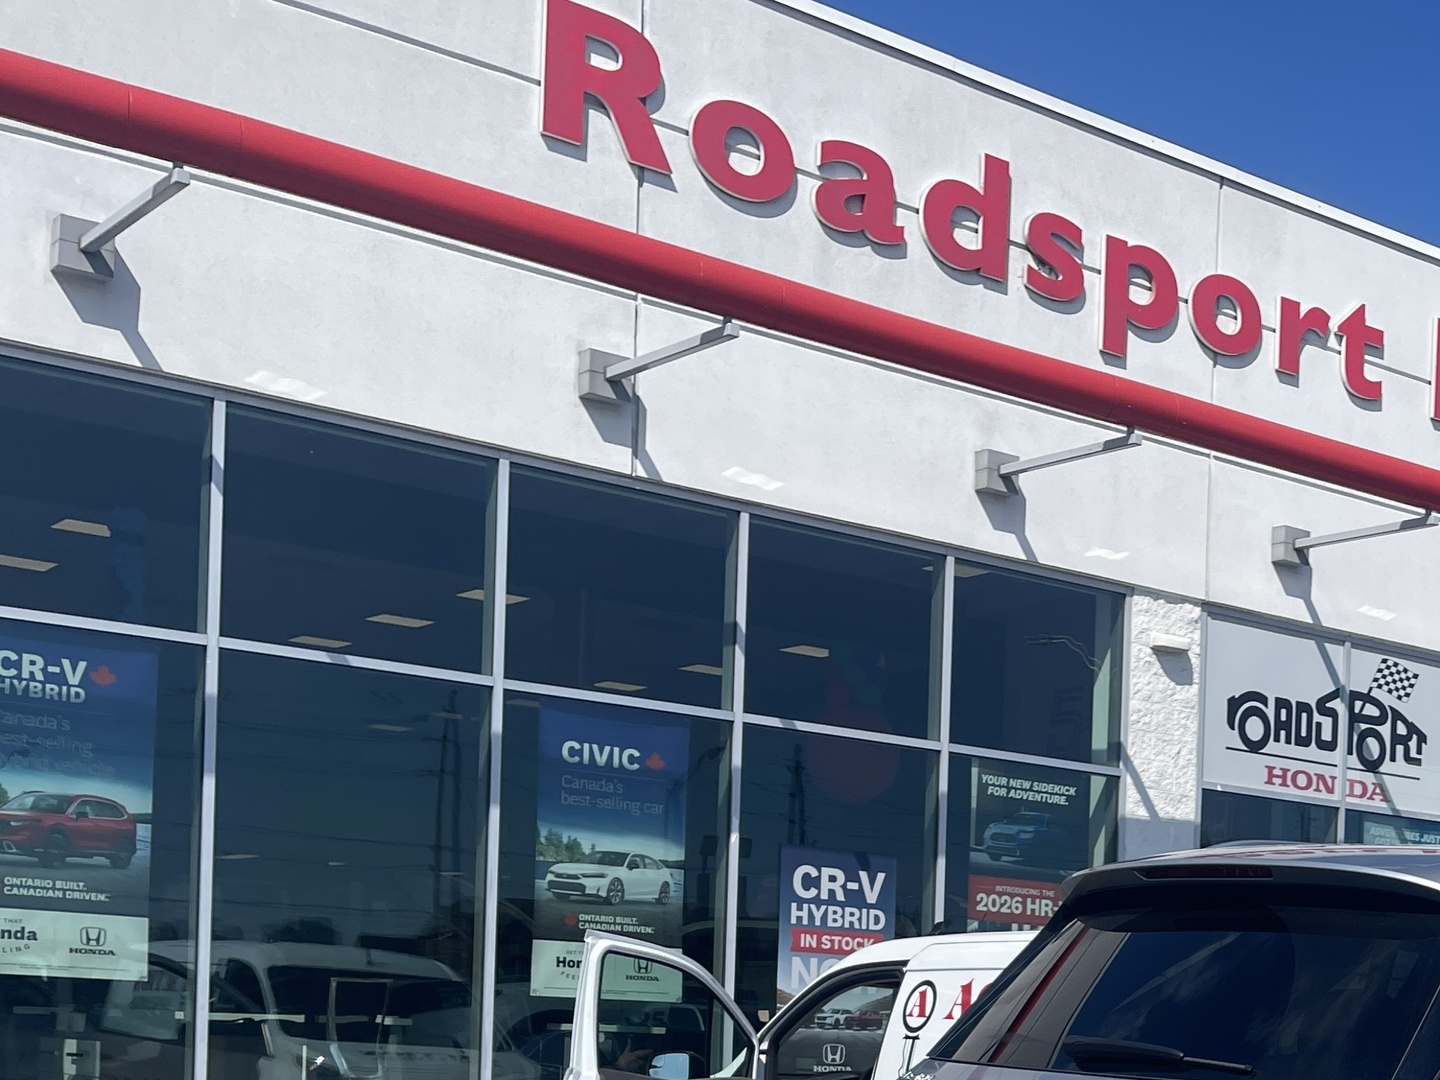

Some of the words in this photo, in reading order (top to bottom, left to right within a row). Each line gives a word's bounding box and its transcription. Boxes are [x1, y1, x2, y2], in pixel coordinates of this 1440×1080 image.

[541, 0, 1384, 400] Roadsport
[0, 650, 87, 685] CR-V
[0, 709, 71, 731] anada's
[0, 731, 93, 759] est-selling
[561, 741, 641, 771] CIVIC
[561, 774, 624, 794] Canada's
[981, 774, 1008, 787] YOUR
[1009, 778, 1032, 790] NEW
[1032, 782, 1077, 796] SIDEKICK
[1264, 765, 1391, 803] HONDA
[561, 790, 641, 816] best-selling
[643, 802, 666, 814] car
[987, 786, 1007, 797] FOR
[1008, 789, 1069, 805] ADVENTURE.
[4, 877, 53, 888] ONTARIO
[4, 886, 63, 898] CANADIAN
[792, 864, 887, 904] CR-V
[995, 885, 1040, 896] INTRODUCING
[1042, 889, 1056, 897] THE
[976, 893, 1023, 915] 2026
[1026, 898, 1063, 917] HR-
[578, 913, 614, 923] ONTARIO
[578, 922, 622, 931] CANADIAN
[790, 902, 886, 931] HYBRID
[0, 926, 38, 942] nda
[800, 933, 817, 948] IN
[69, 947, 116, 957] HONDA
[625, 974, 660, 982] HONDA
[906, 986, 930, 1018] A
